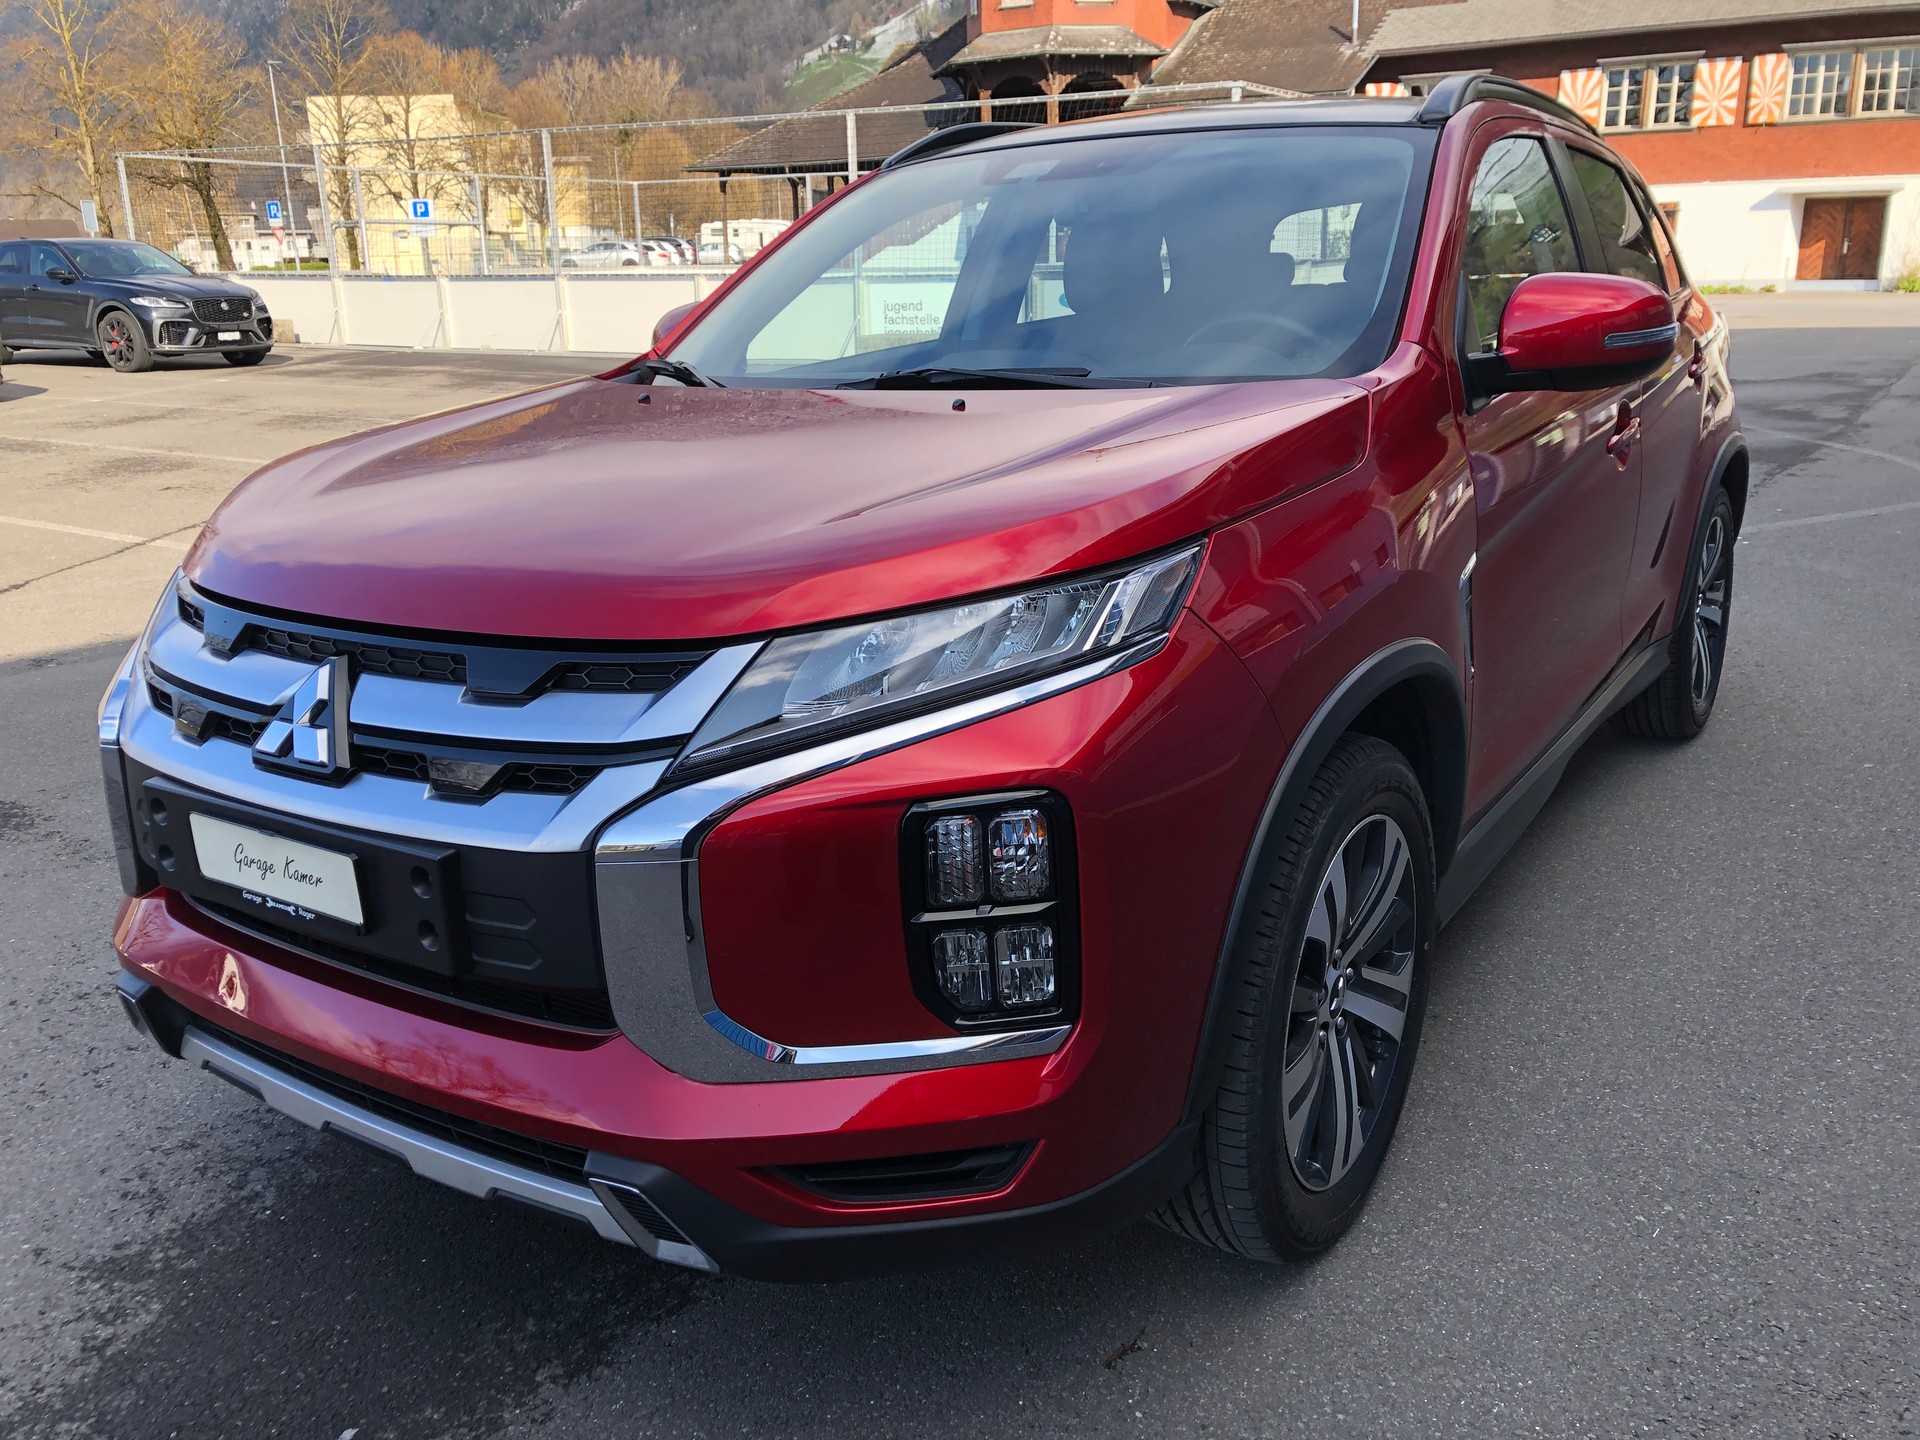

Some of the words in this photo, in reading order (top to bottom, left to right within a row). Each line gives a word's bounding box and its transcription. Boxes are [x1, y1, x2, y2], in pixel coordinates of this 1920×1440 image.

[416, 203, 426, 217] P
[883, 300, 923, 314] jugend
[884, 314, 941, 325] fachstelle
[234, 843, 276, 881] Garage
[283, 856, 323, 887] Kamer
[242, 890, 263, 904] Garage
